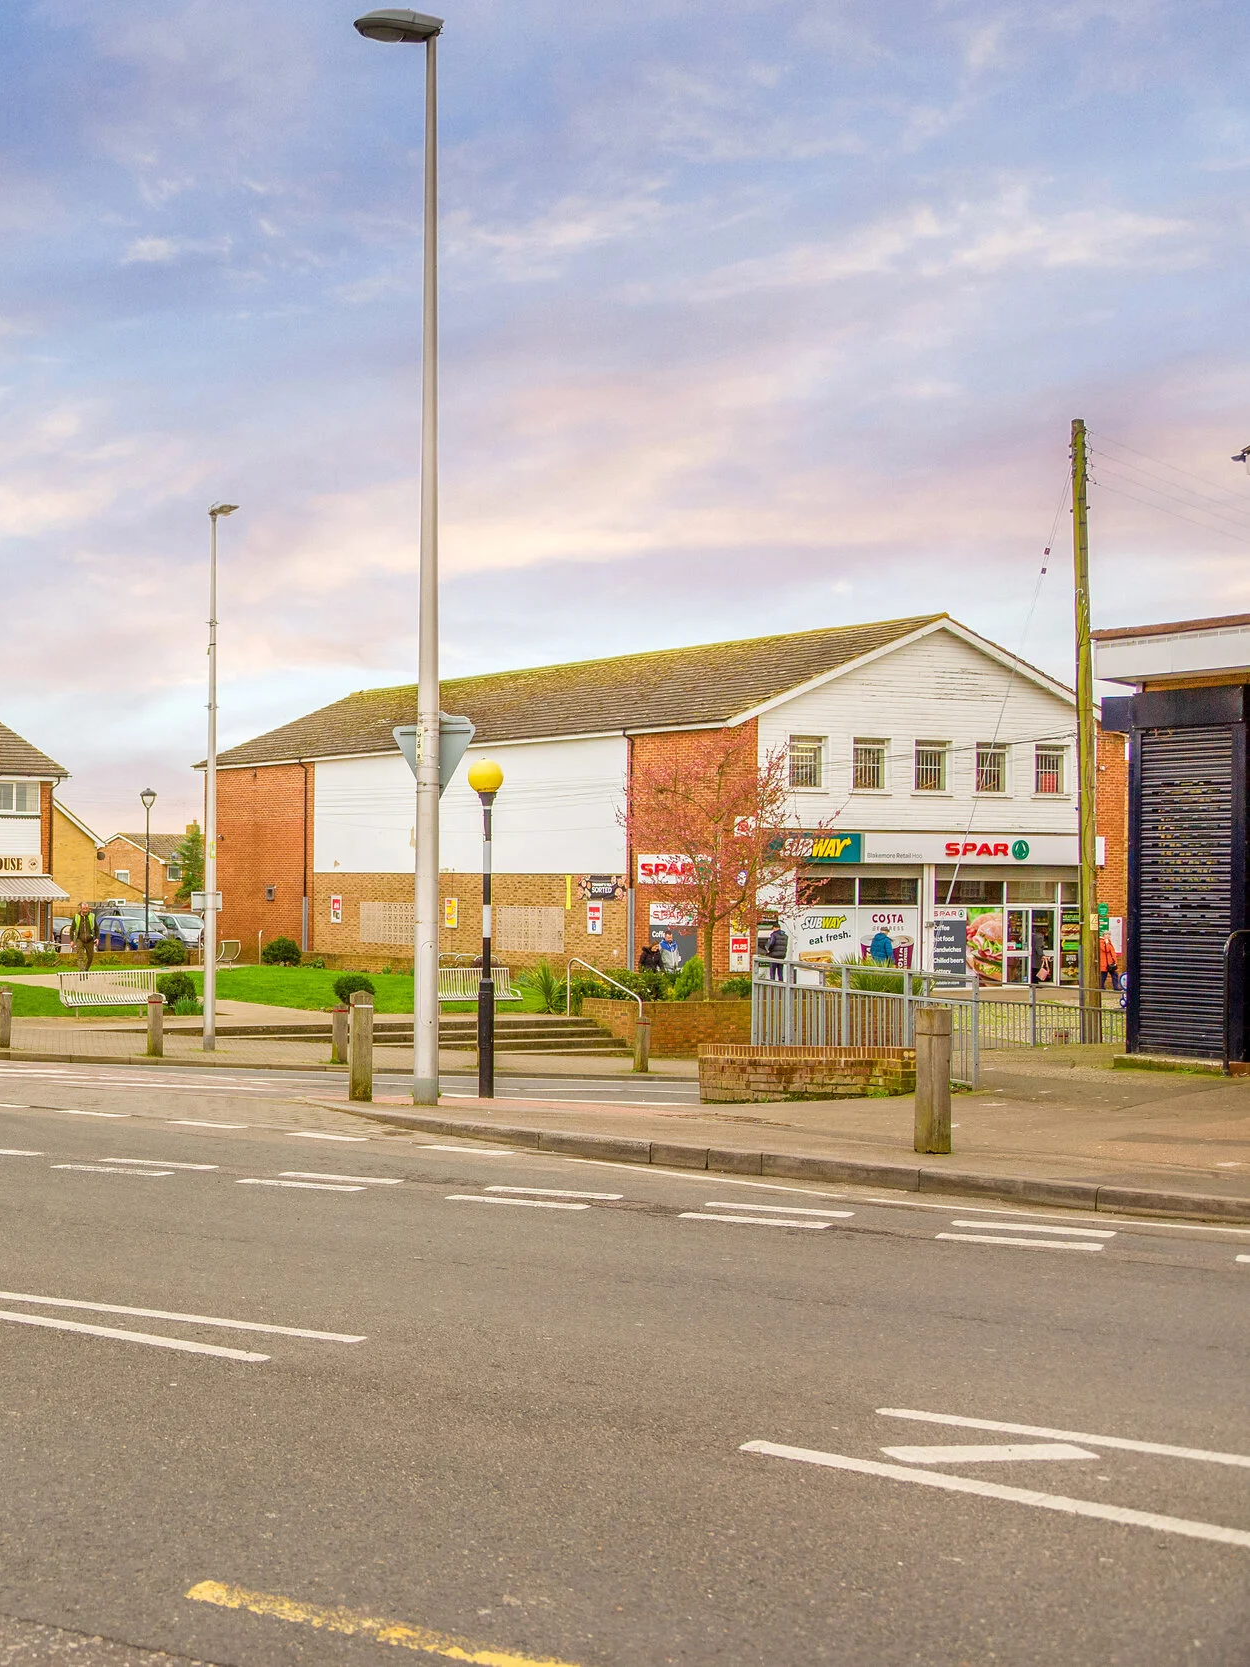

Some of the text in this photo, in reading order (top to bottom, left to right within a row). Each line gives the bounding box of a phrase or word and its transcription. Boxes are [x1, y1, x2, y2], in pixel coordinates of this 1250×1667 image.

[780, 837, 852, 857] SUBWAY
[945, 842, 1009, 857] SPAR
[640, 863, 694, 876] SPAR
[591, 886, 613, 894] SORTED
[800, 915, 847, 930] SUBWAY
[872, 914, 904, 924] COSTA
[809, 930, 852, 945] eat fresh.
